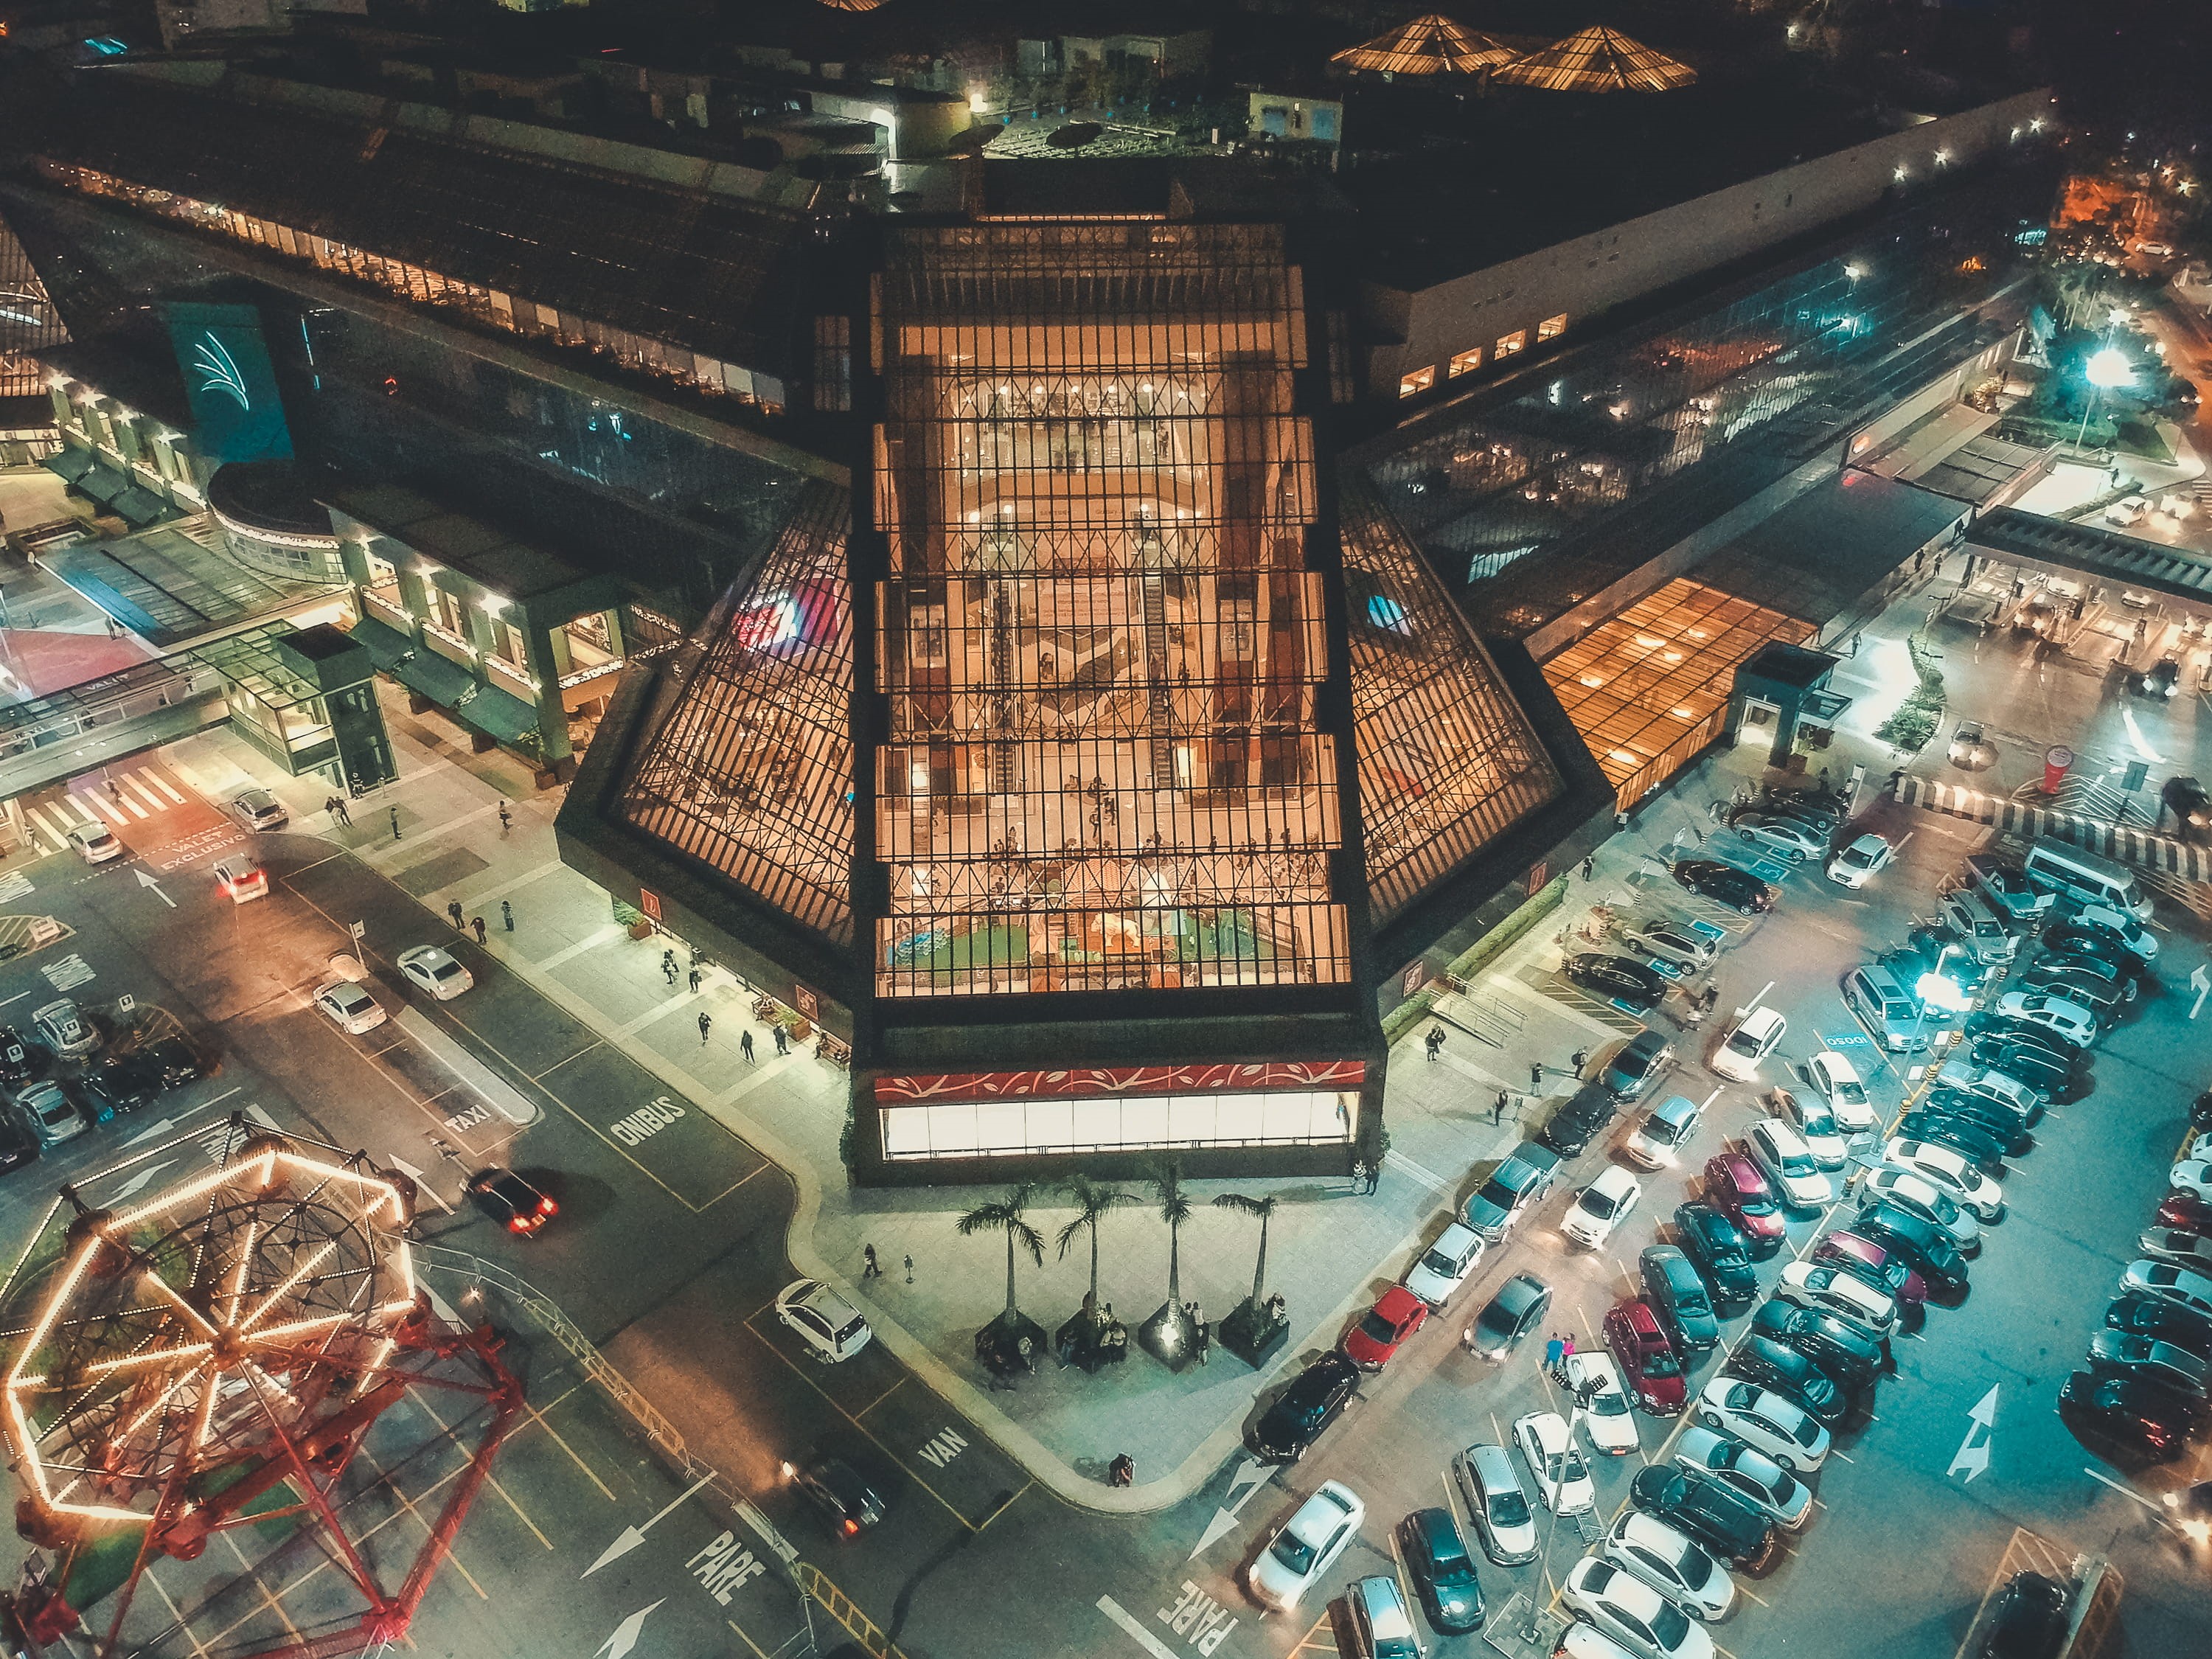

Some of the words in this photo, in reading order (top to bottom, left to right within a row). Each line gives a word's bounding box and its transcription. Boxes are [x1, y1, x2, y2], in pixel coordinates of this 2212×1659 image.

[160, 834, 247, 871] EXCLUSIVO
[172, 831, 223, 853] VALET
[1826, 1036, 1868, 1046] IDOSO
[443, 1104, 492, 1133] TAXI
[610, 1096, 686, 1147] ONIBUS
[917, 1426, 969, 1468] VAN
[684, 1529, 767, 1606] PARE
[1156, 1579, 1239, 1658] PARE
